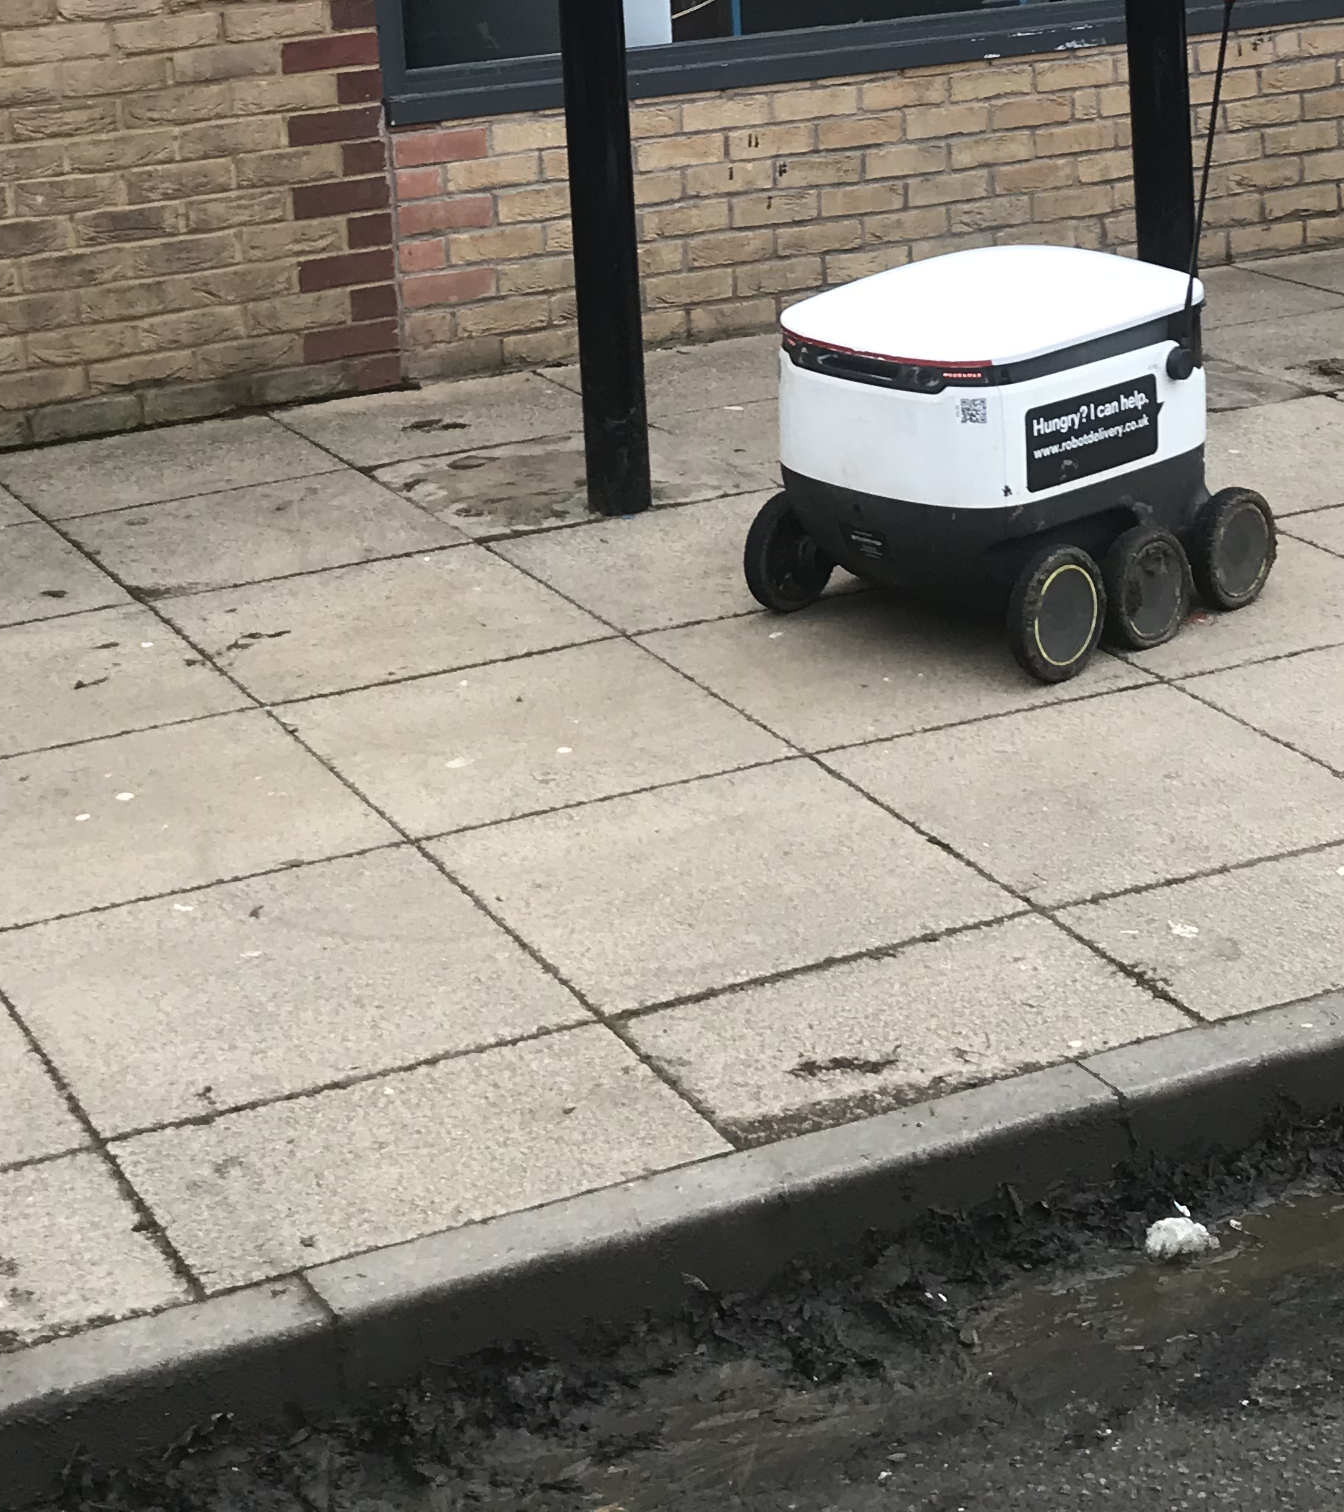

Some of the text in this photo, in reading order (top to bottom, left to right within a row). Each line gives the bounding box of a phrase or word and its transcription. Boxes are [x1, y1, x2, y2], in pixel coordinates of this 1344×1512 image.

[1032, 390, 1149, 436] Hungry? I can help.
